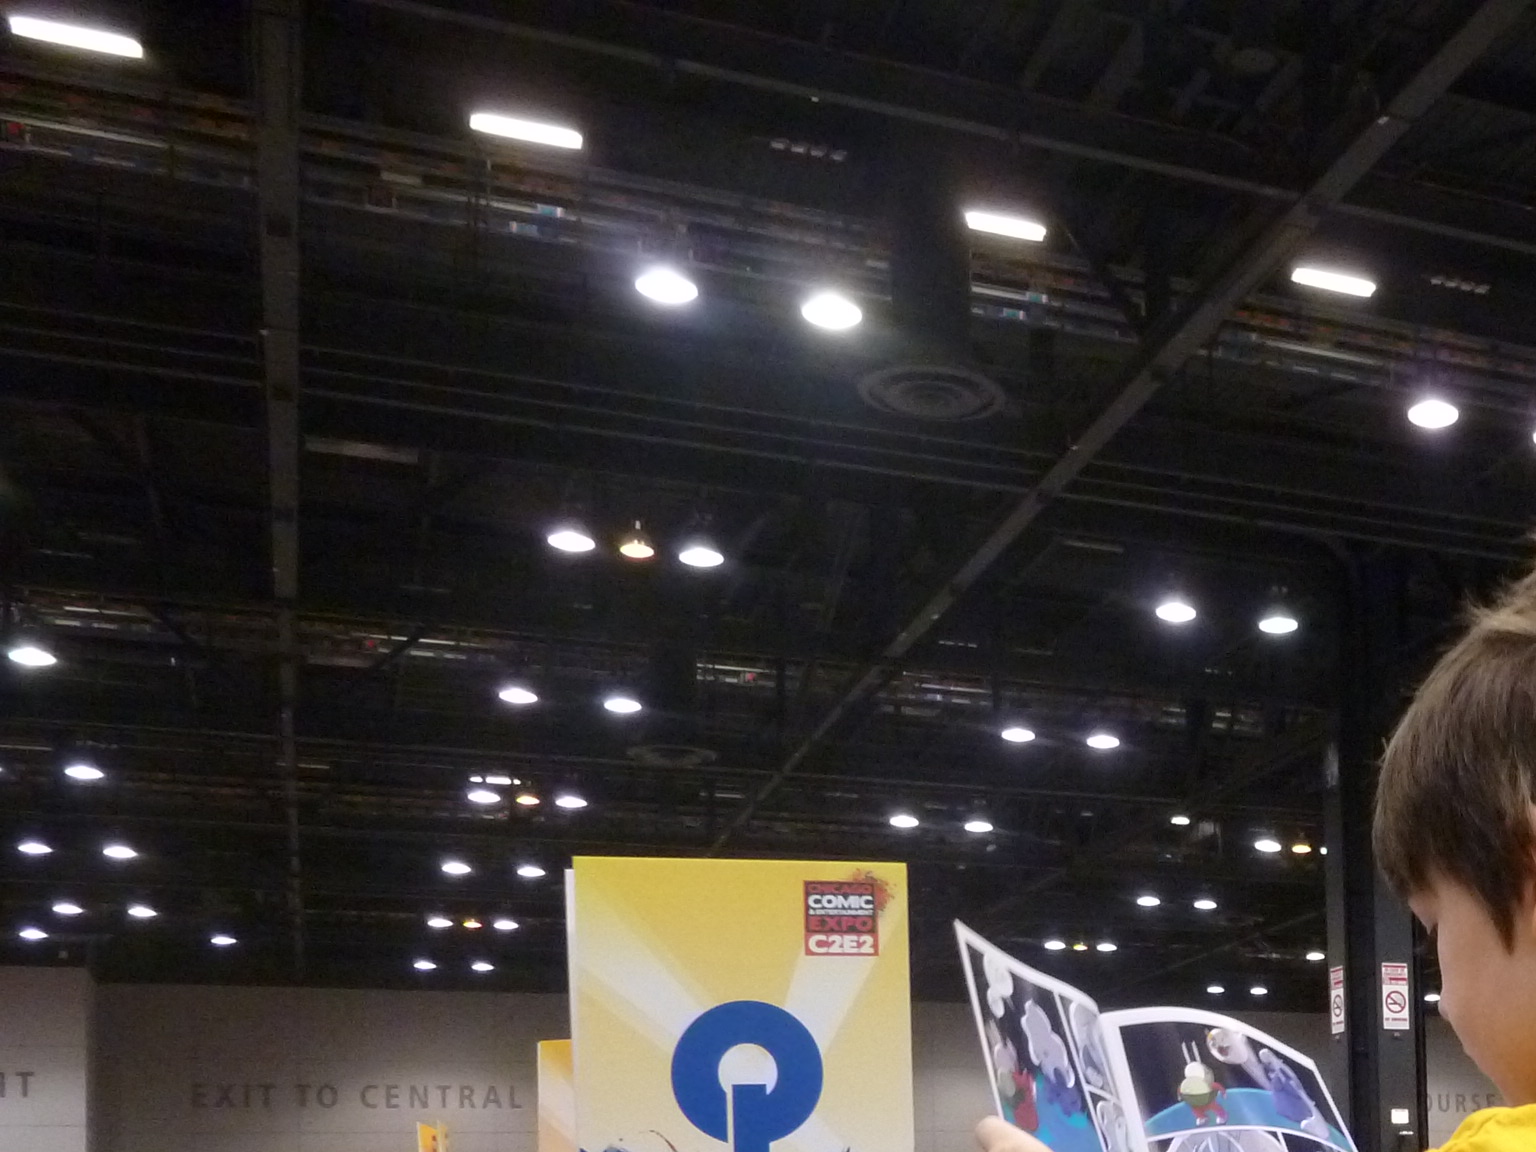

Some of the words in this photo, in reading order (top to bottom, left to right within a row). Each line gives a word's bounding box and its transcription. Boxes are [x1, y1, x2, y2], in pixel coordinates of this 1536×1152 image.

[808, 895, 874, 909] COMIC
[810, 917, 873, 931] EXPO
[808, 935, 875, 954] C2E2
[0, 1071, 35, 1098] IT
[192, 1084, 276, 1109] EXIT
[296, 1084, 338, 1109] TO
[360, 1084, 523, 1109] CENTRAL
